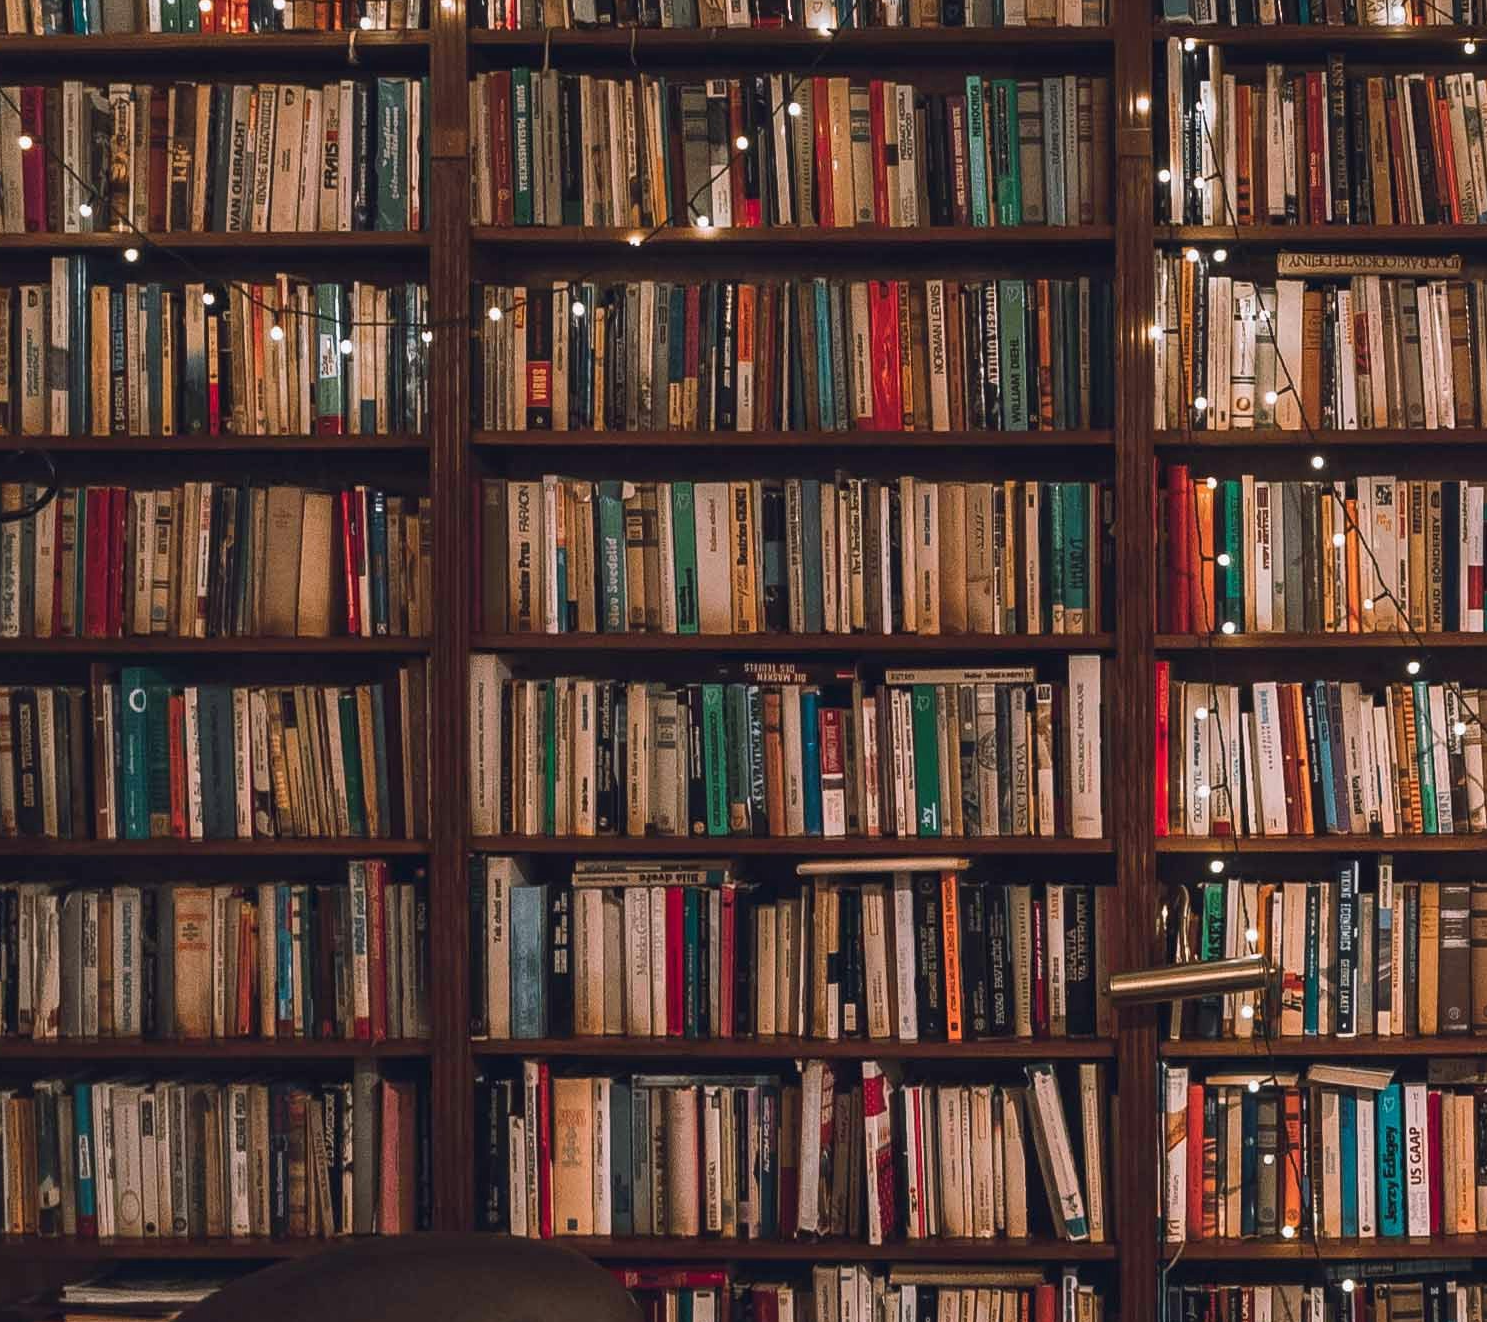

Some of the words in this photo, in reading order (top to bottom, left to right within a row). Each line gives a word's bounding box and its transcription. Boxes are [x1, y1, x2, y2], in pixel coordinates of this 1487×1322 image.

[970, 85, 981, 137] NEMOCNICA
[232, 119, 246, 195] OLBRACHT
[230, 199, 241, 231] IVAN
[930, 285, 942, 321] LEWIS
[932, 325, 944, 375] NORMAN
[1010, 337, 1020, 369] DIEHL
[1010, 375, 1022, 423] WILLIAM
[518, 484, 530, 533] FARAON
[1432, 589, 1441, 624] KNUD
[1340, 869, 1352, 897] VIKING
[1340, 903, 1352, 951] ECONOMICS
[1382, 1126, 1398, 1179] Edigey
[1409, 1127, 1420, 1164] GAAP
[1410, 1167, 1421, 1185] US
[1384, 1183, 1398, 1224] Jerzy
